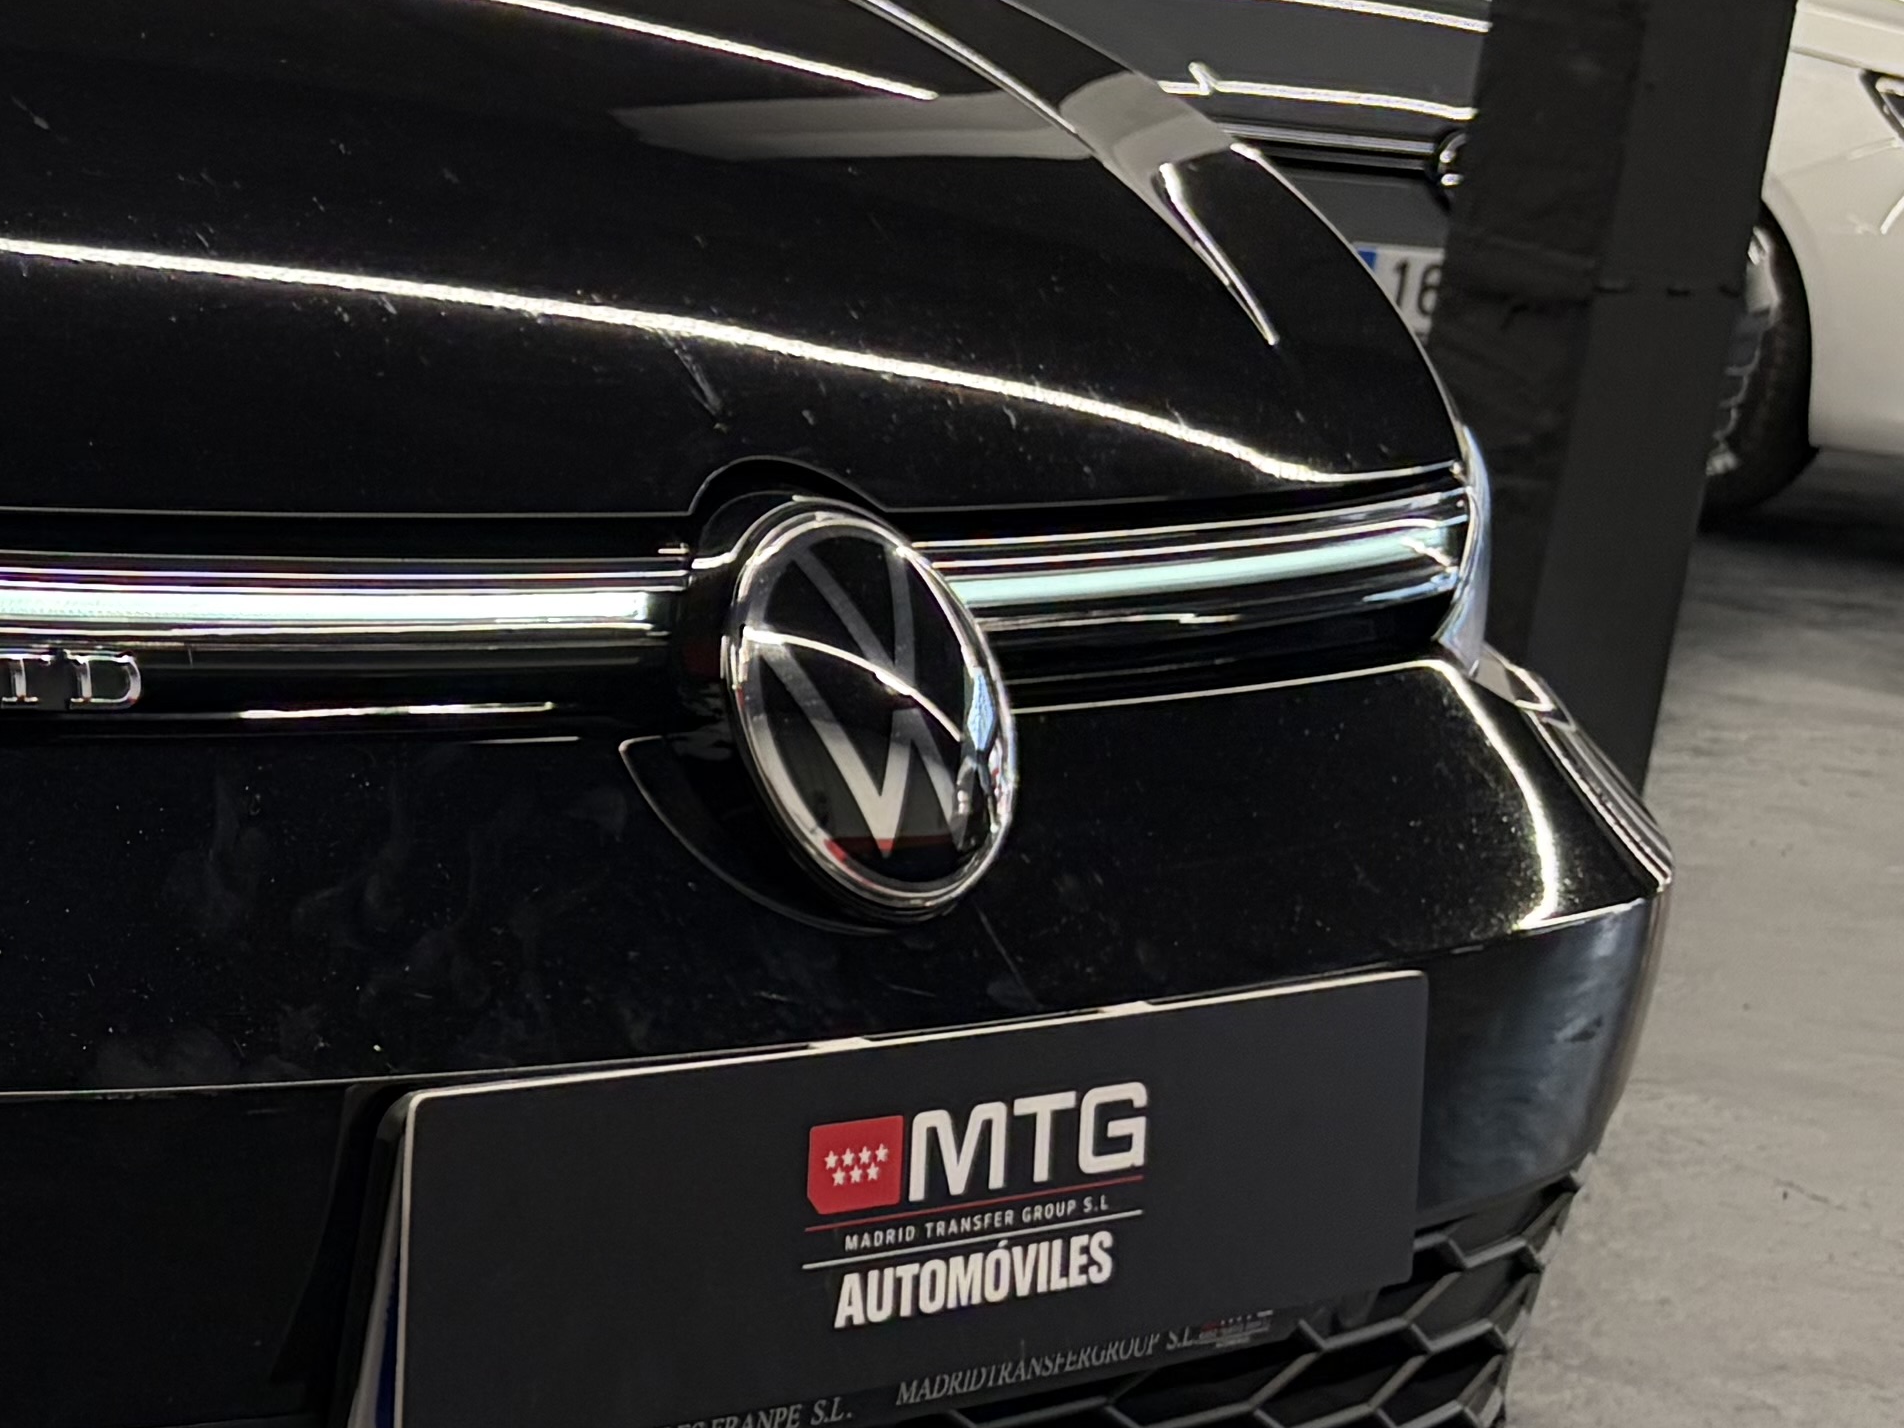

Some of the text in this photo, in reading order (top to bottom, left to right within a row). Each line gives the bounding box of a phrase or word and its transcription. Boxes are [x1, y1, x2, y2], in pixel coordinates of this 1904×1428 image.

[908, 1082, 1148, 1203] MTG
[844, 1226, 916, 1252] MADRID
[924, 1208, 1014, 1239] TRANSFER
[1021, 1200, 1078, 1224] GROUP
[833, 1229, 1114, 1329] AUTOMÓVILES
[809, 1396, 853, 1426] S.L.
